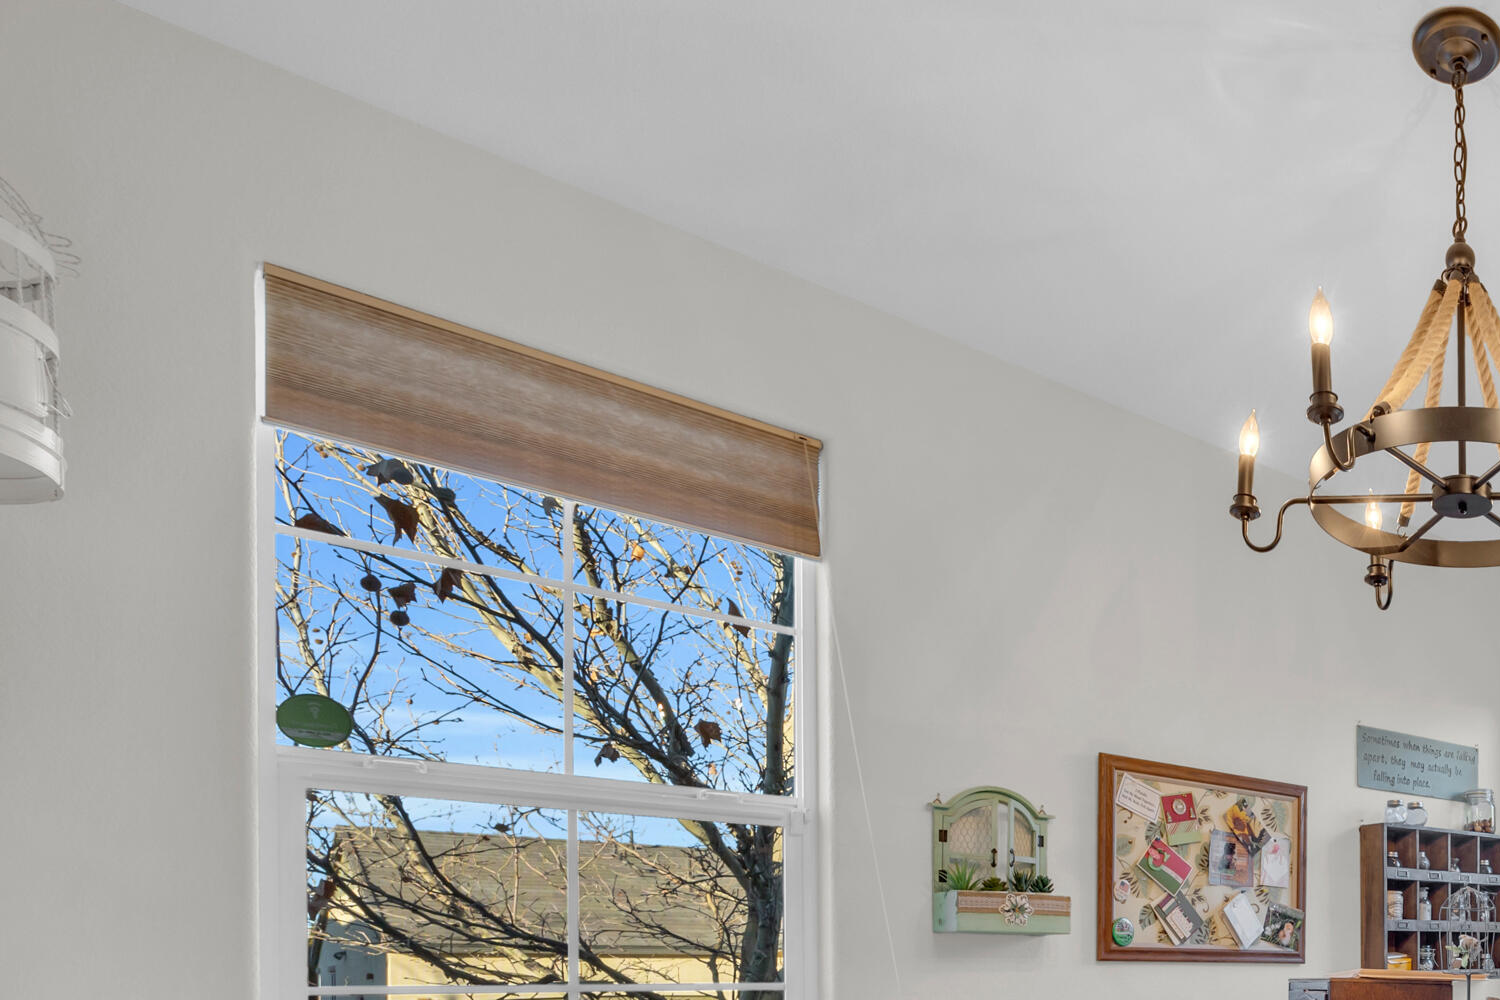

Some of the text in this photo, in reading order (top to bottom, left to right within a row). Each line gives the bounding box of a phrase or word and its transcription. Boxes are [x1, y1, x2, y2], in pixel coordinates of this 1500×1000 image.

[1362, 733, 1400, 749] Sometimes
[1403, 740, 1420, 752] when
[1423, 744, 1442, 758] things
[1444, 750, 1454, 759] are
[1373, 769, 1396, 787] falling
[1397, 774, 1411, 785] into
[1390, 755, 1406, 770] they
[1410, 760, 1425, 773] may
[1428, 763, 1452, 778] actually
